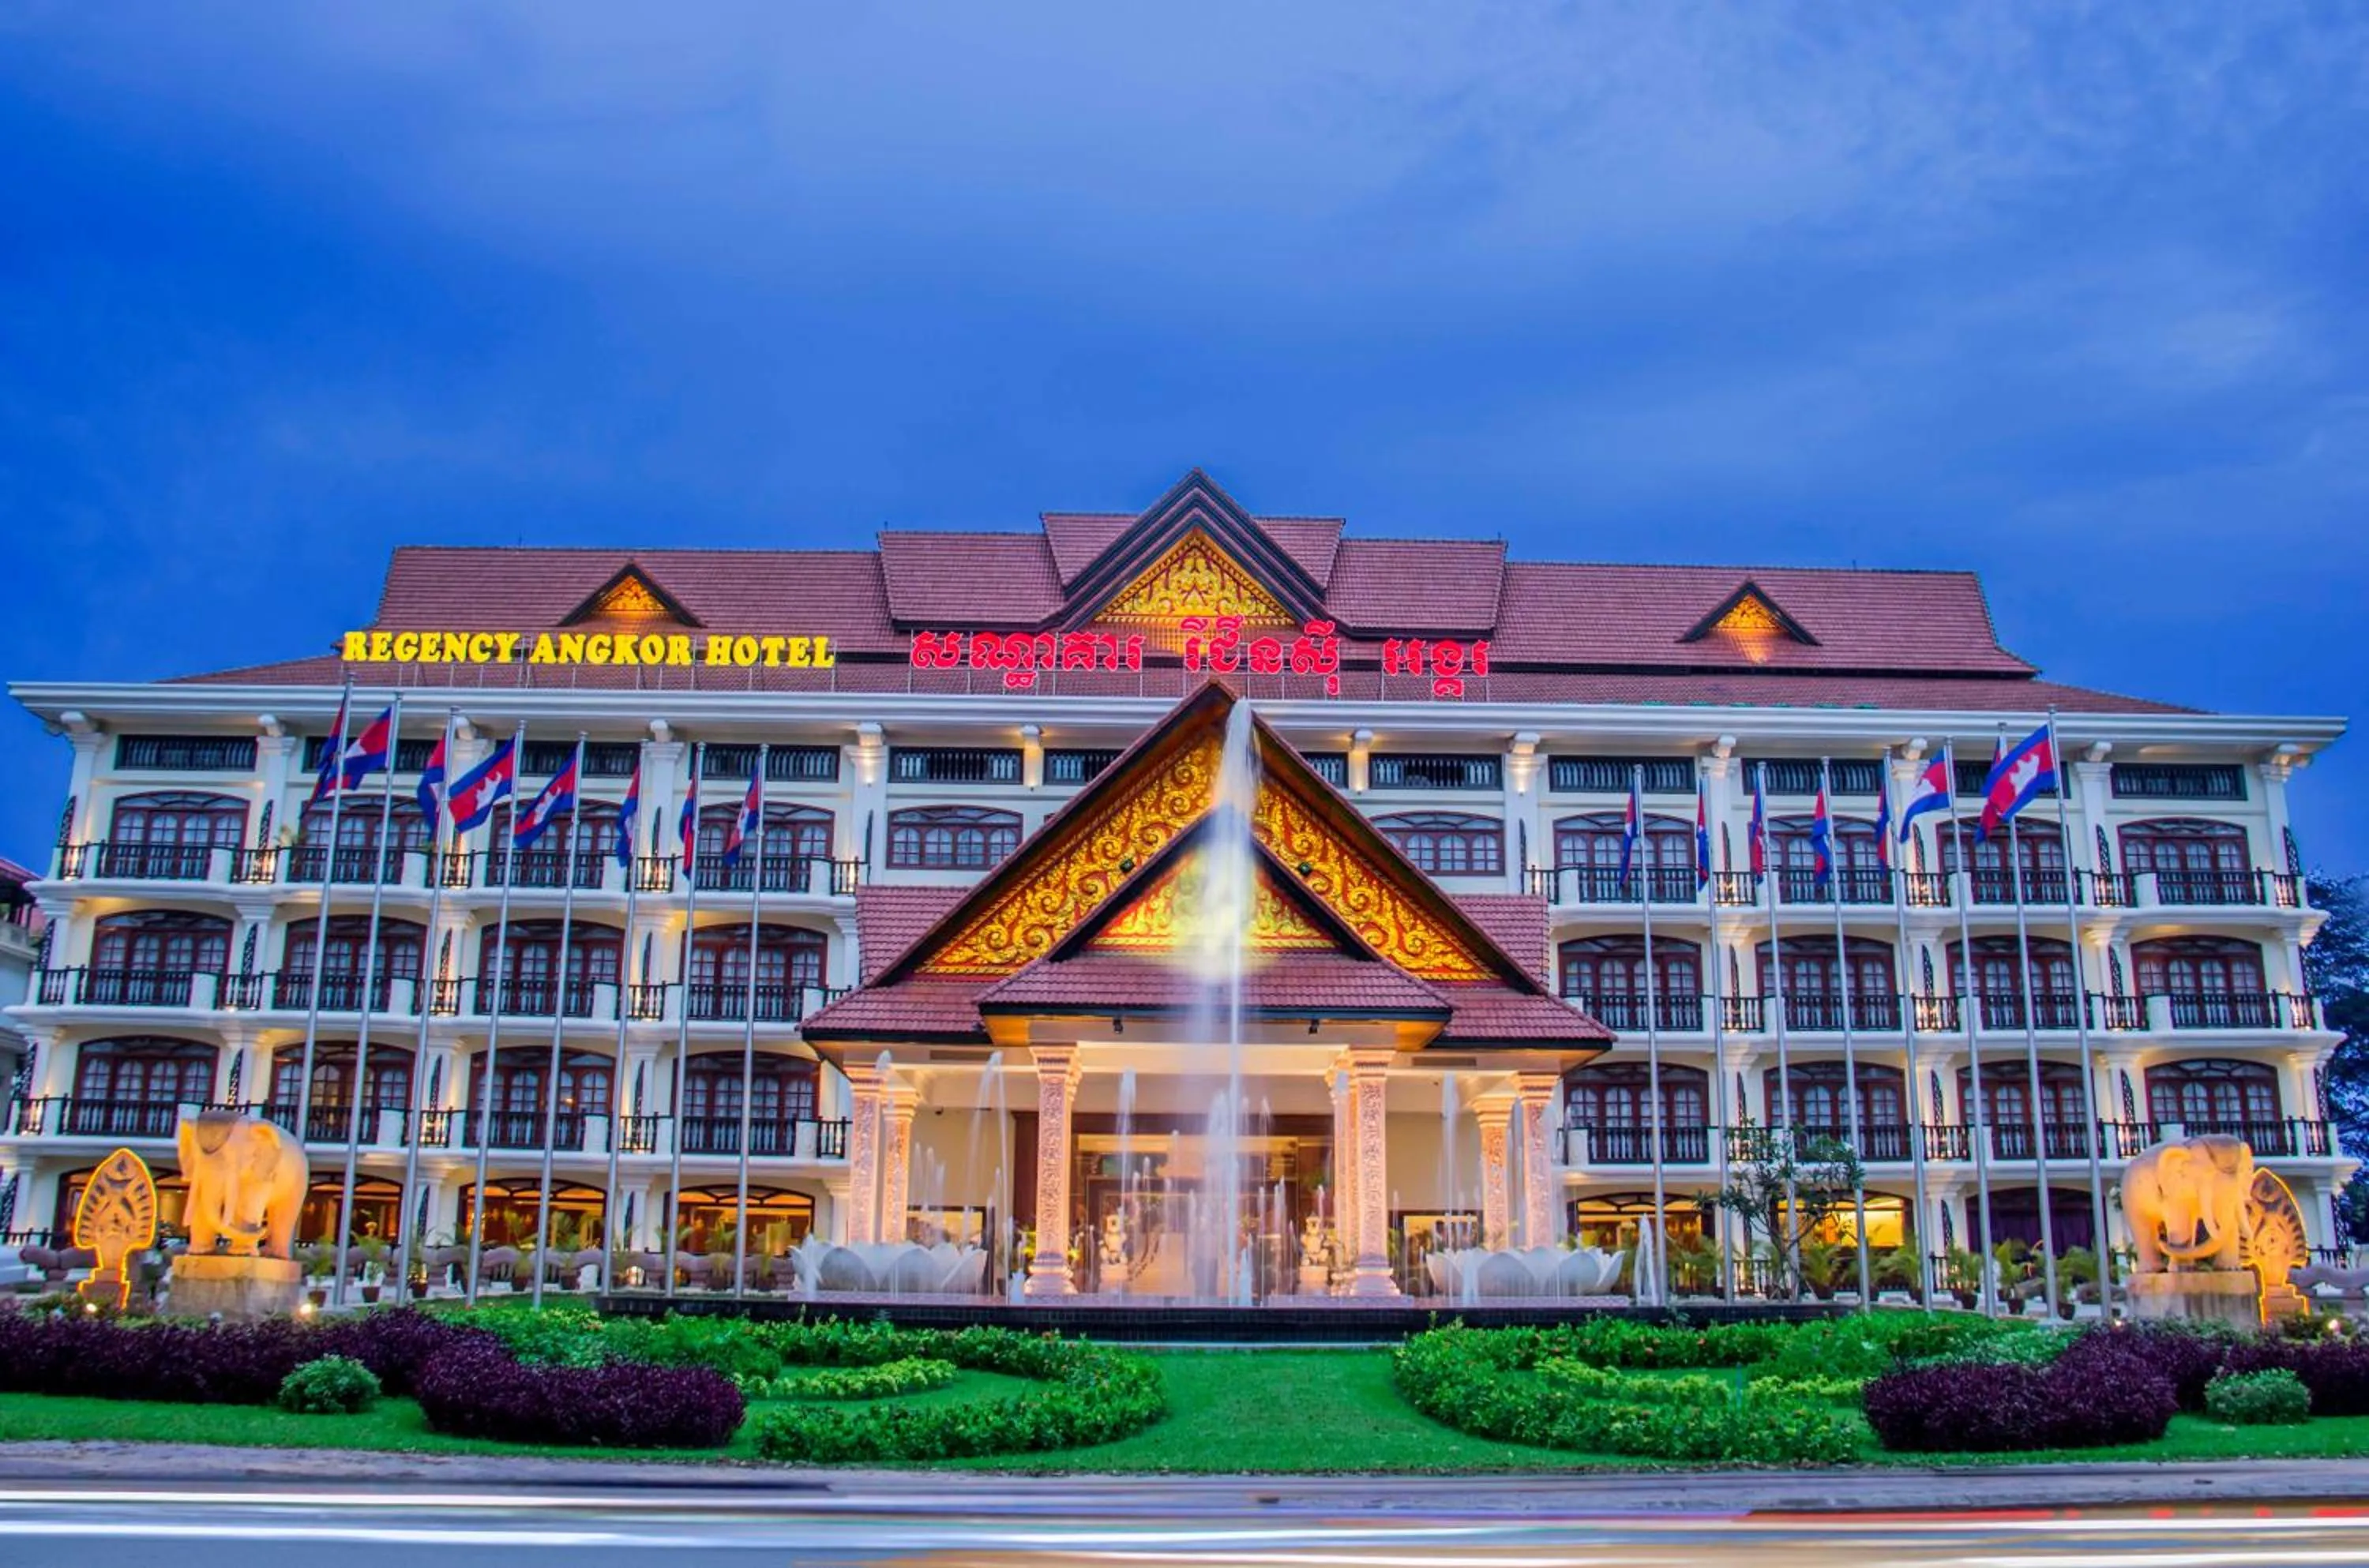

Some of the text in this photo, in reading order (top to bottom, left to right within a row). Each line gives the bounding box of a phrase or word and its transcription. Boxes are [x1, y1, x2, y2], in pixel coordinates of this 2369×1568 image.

[342, 631, 835, 668] REGENCY ANGKOR HOTEL
[1382, 637, 1491, 697] អង្គរ
